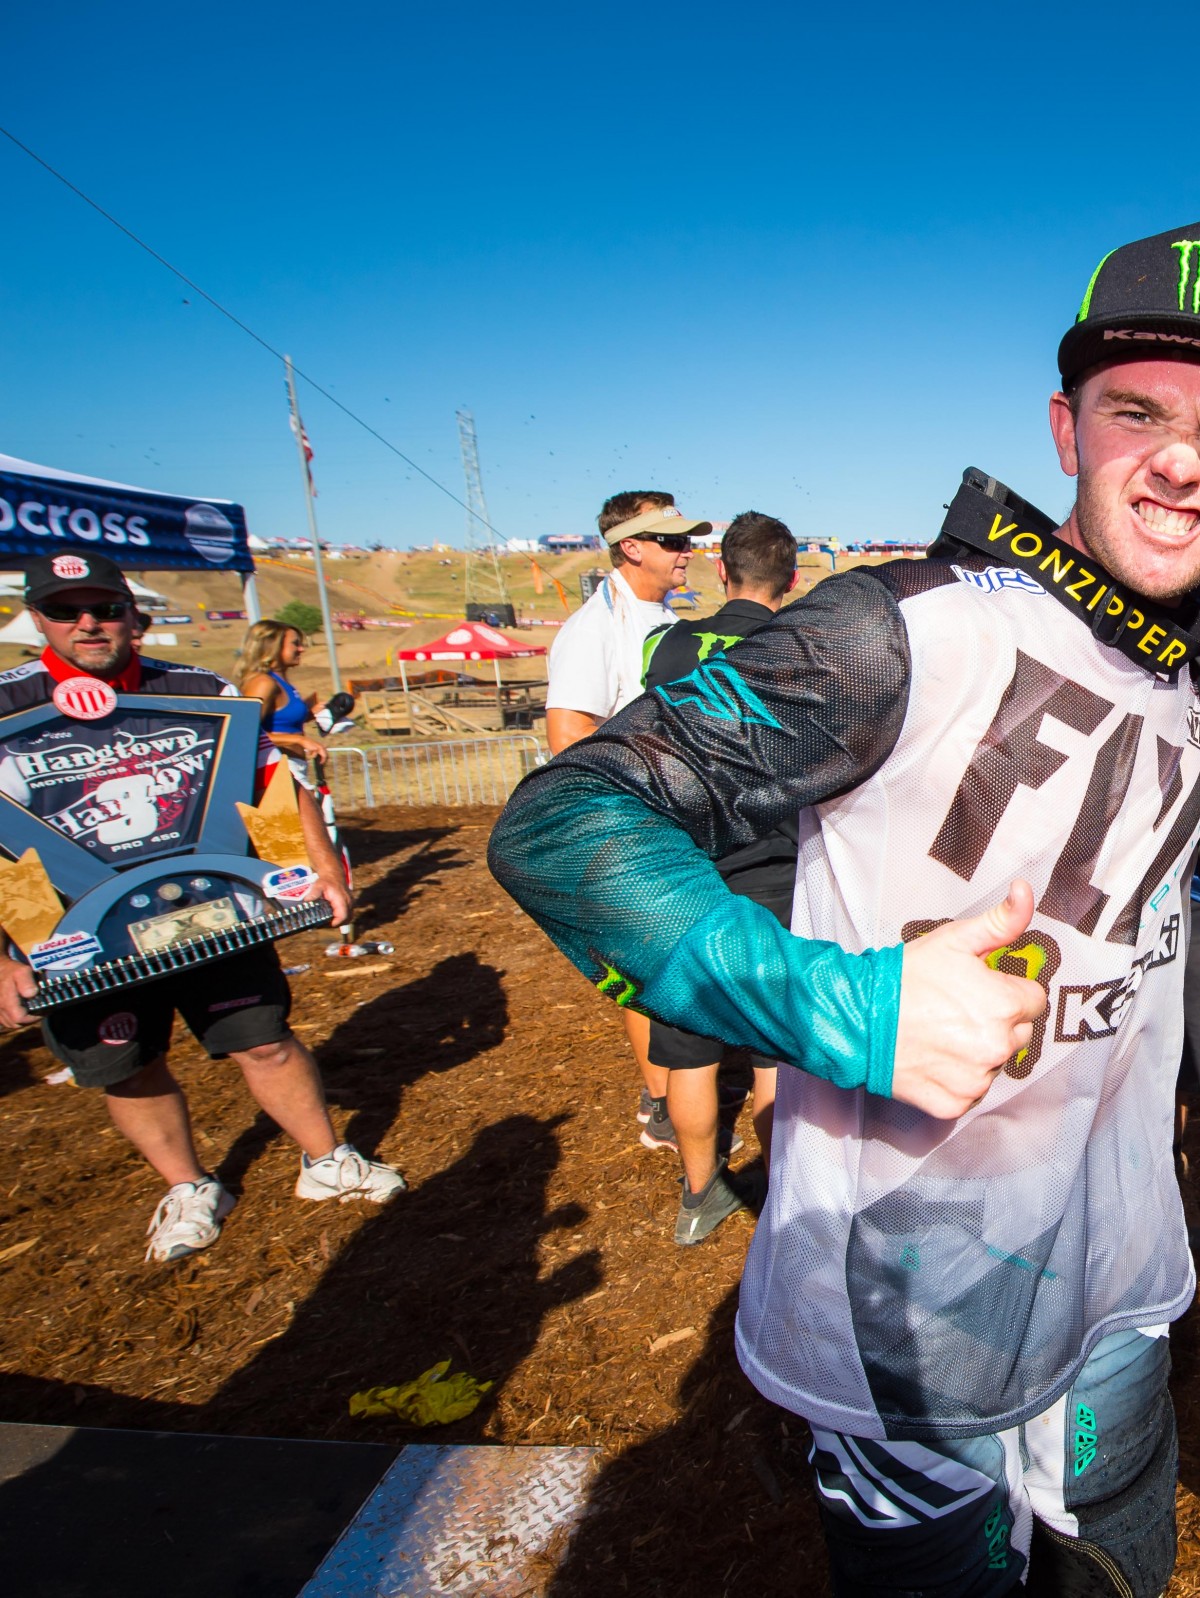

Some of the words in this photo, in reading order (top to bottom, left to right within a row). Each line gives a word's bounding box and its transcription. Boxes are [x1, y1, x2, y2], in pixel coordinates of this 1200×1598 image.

[986, 513, 1188, 668] VONZIPPER
[0, 667, 30, 682] MC
[16, 735, 198, 778] Hangtown
[30, 766, 127, 789] MOTOCROSS
[111, 840, 144, 853] PRO
[151, 831, 181, 844] 450
